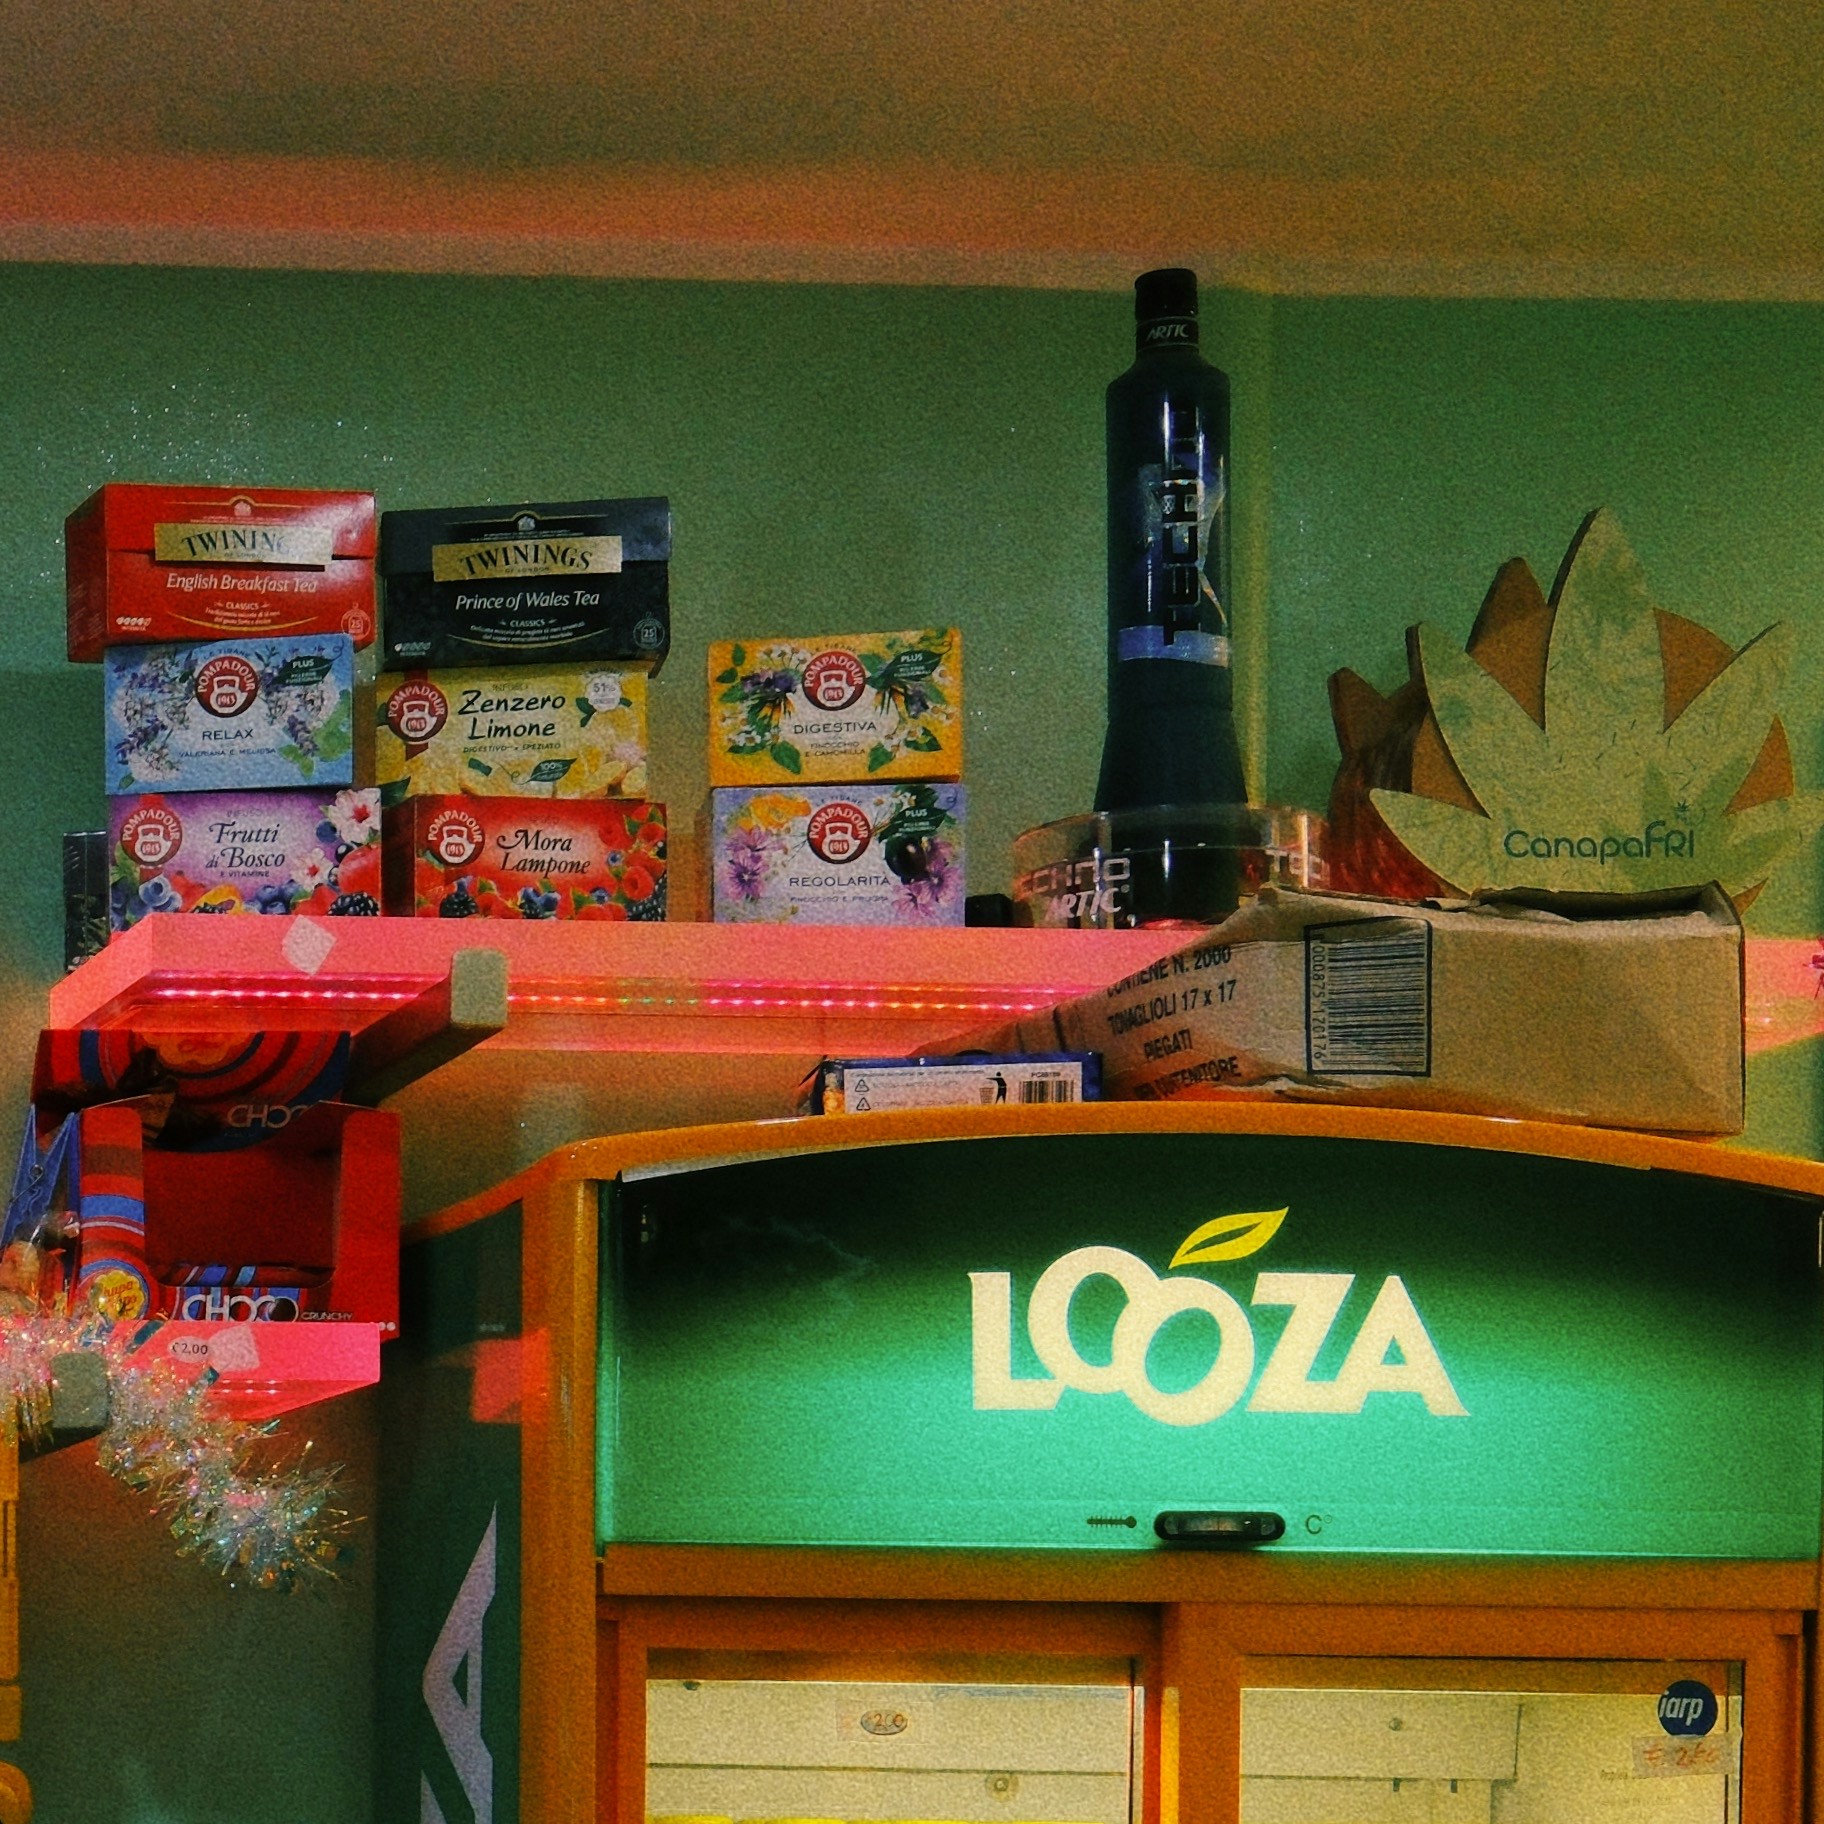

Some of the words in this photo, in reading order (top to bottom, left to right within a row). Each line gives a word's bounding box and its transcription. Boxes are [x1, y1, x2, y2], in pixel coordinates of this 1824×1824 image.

[1145, 323, 1190, 341] ARTIC
[459, 544, 593, 577] TWININGS
[166, 573, 218, 592] English
[220, 574, 290, 594] Breakfast
[294, 578, 319, 593] Tea
[225, 601, 260, 610] CLASSICS
[455, 595, 503, 611] Prince
[506, 593, 521, 610] of
[525, 592, 570, 608] Wales
[573, 590, 601, 606] Tea
[510, 618, 546, 628] CLASSICS
[292, 658, 315, 670] PLUS
[901, 652, 924, 663] PLUS
[196, 657, 258, 693] POMPADOUR
[803, 652, 865, 688] POMPADOUR
[387, 681, 447, 717] POMPADOUR
[457, 689, 567, 716] Zenzero
[202, 728, 256, 741] RELAX
[467, 717, 557, 740] Limone
[793, 721, 878, 735] DIGESTIVA
[122, 808, 181, 842] POMPADOUR
[208, 822, 281, 844] Frutti
[427, 809, 483, 843] POMPADOUR
[496, 829, 573, 852] Mora
[205, 856, 219, 868] di
[220, 846, 286, 868] Bosco
[500, 852, 591, 878] Lampone
[1171, 954, 1190, 976] N.
[1194, 944, 1232, 970] 2000
[1107, 991, 1177, 1037] TOVAGLIOLI
[1181, 989, 1199, 1011] 17
[1203, 992, 1213, 1008] x
[1217, 980, 1237, 1004] 17
[1143, 1028, 1192, 1061] PIEGATI
[301, 1310, 353, 1322] CRUNCHY
[968, 1244, 1471, 1427] LOOZA
[1658, 1687, 1704, 1731] iarp
